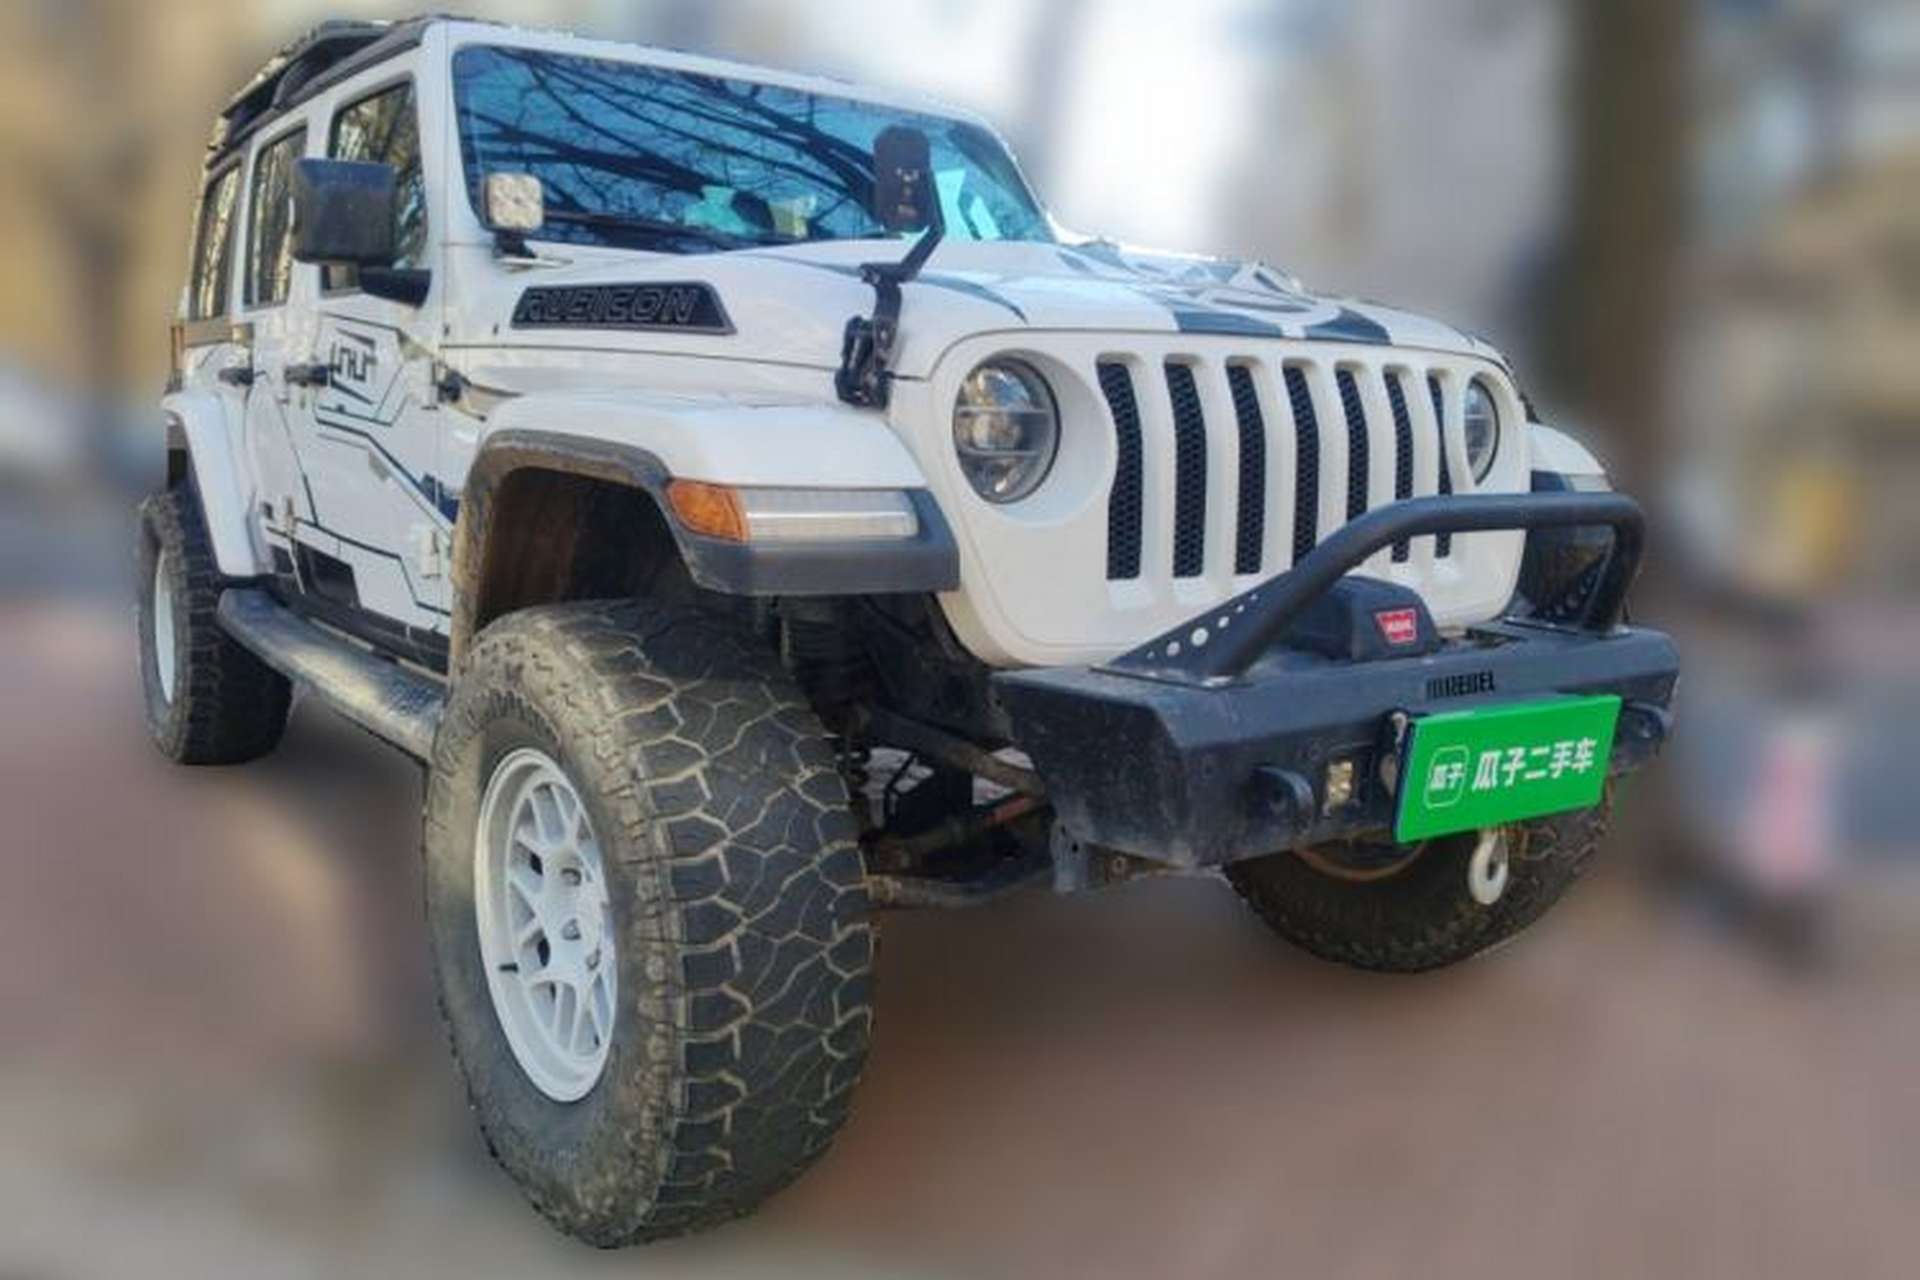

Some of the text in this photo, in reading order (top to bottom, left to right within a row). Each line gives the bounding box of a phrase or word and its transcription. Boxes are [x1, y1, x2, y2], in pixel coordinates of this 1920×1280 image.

[1472, 737, 1597, 792] 瓜子二手车
